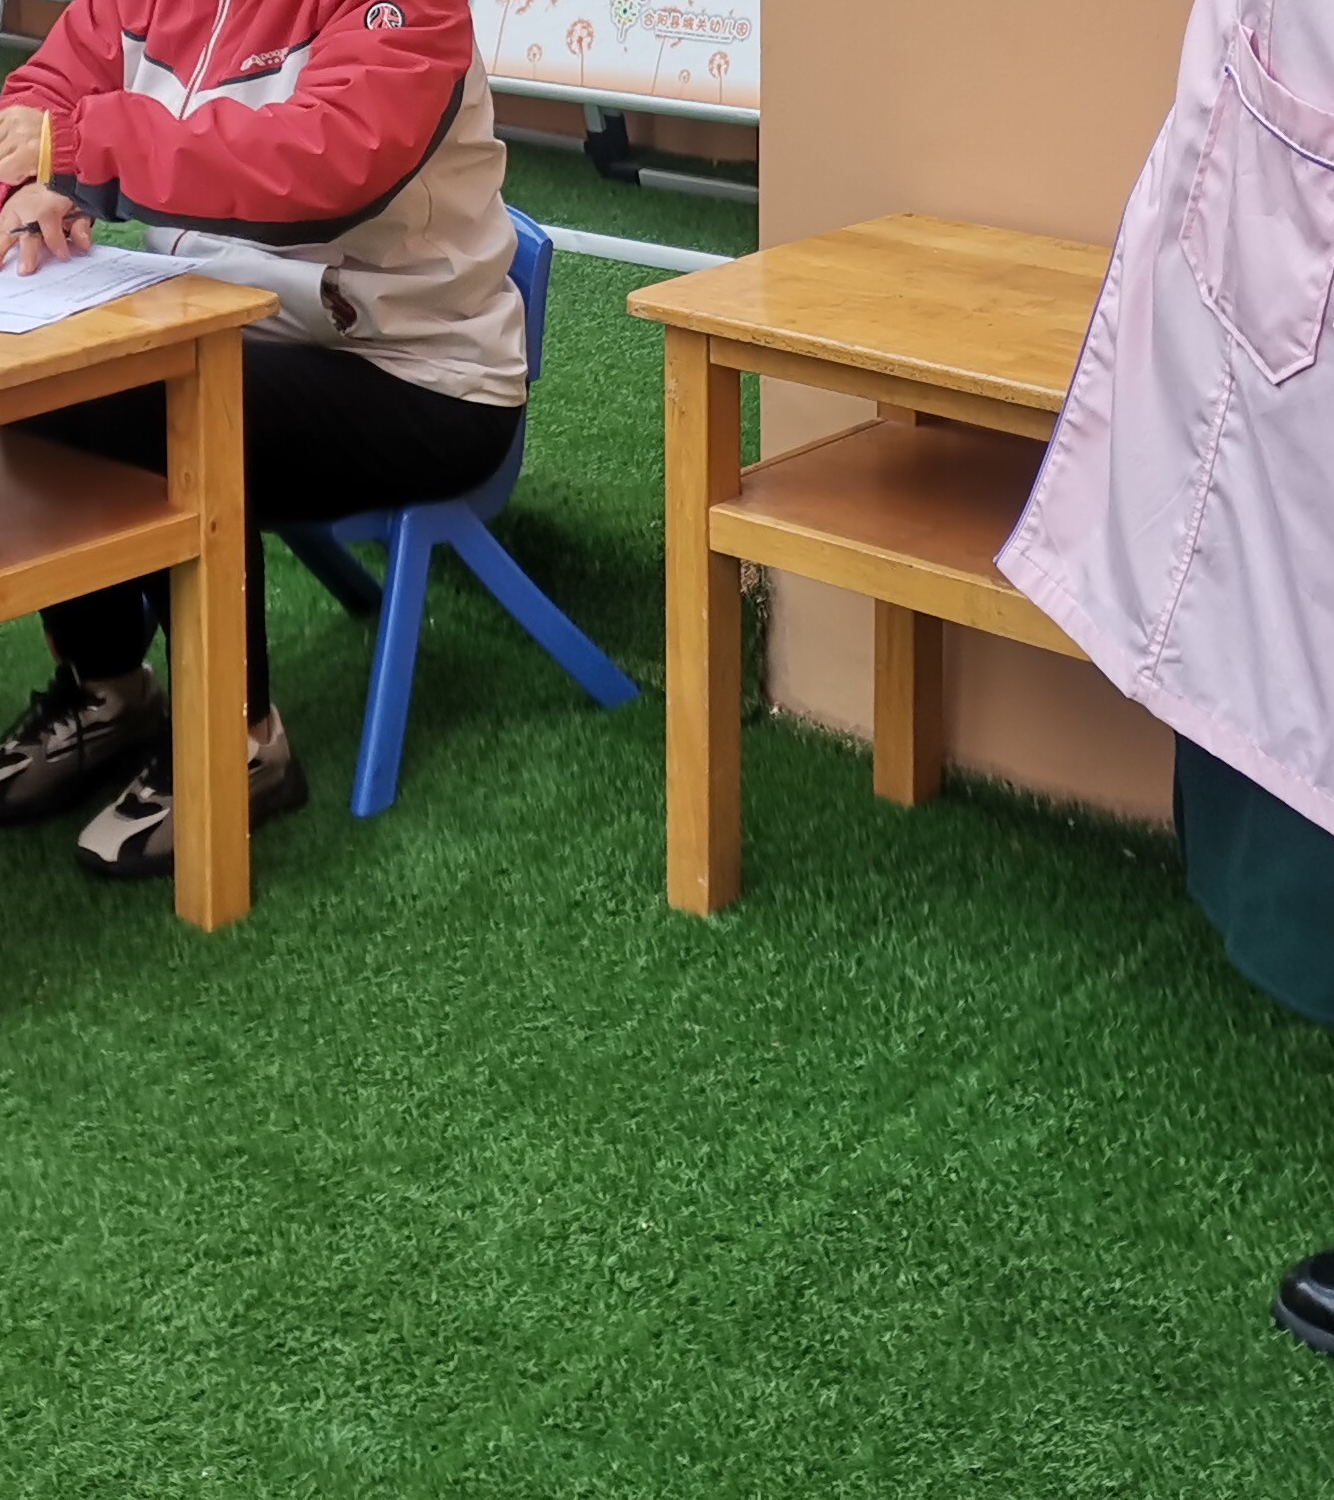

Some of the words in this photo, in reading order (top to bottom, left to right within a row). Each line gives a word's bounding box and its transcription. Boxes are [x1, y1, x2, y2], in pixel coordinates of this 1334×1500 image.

[643, 12, 749, 37] 合阳县城关幼儿园
